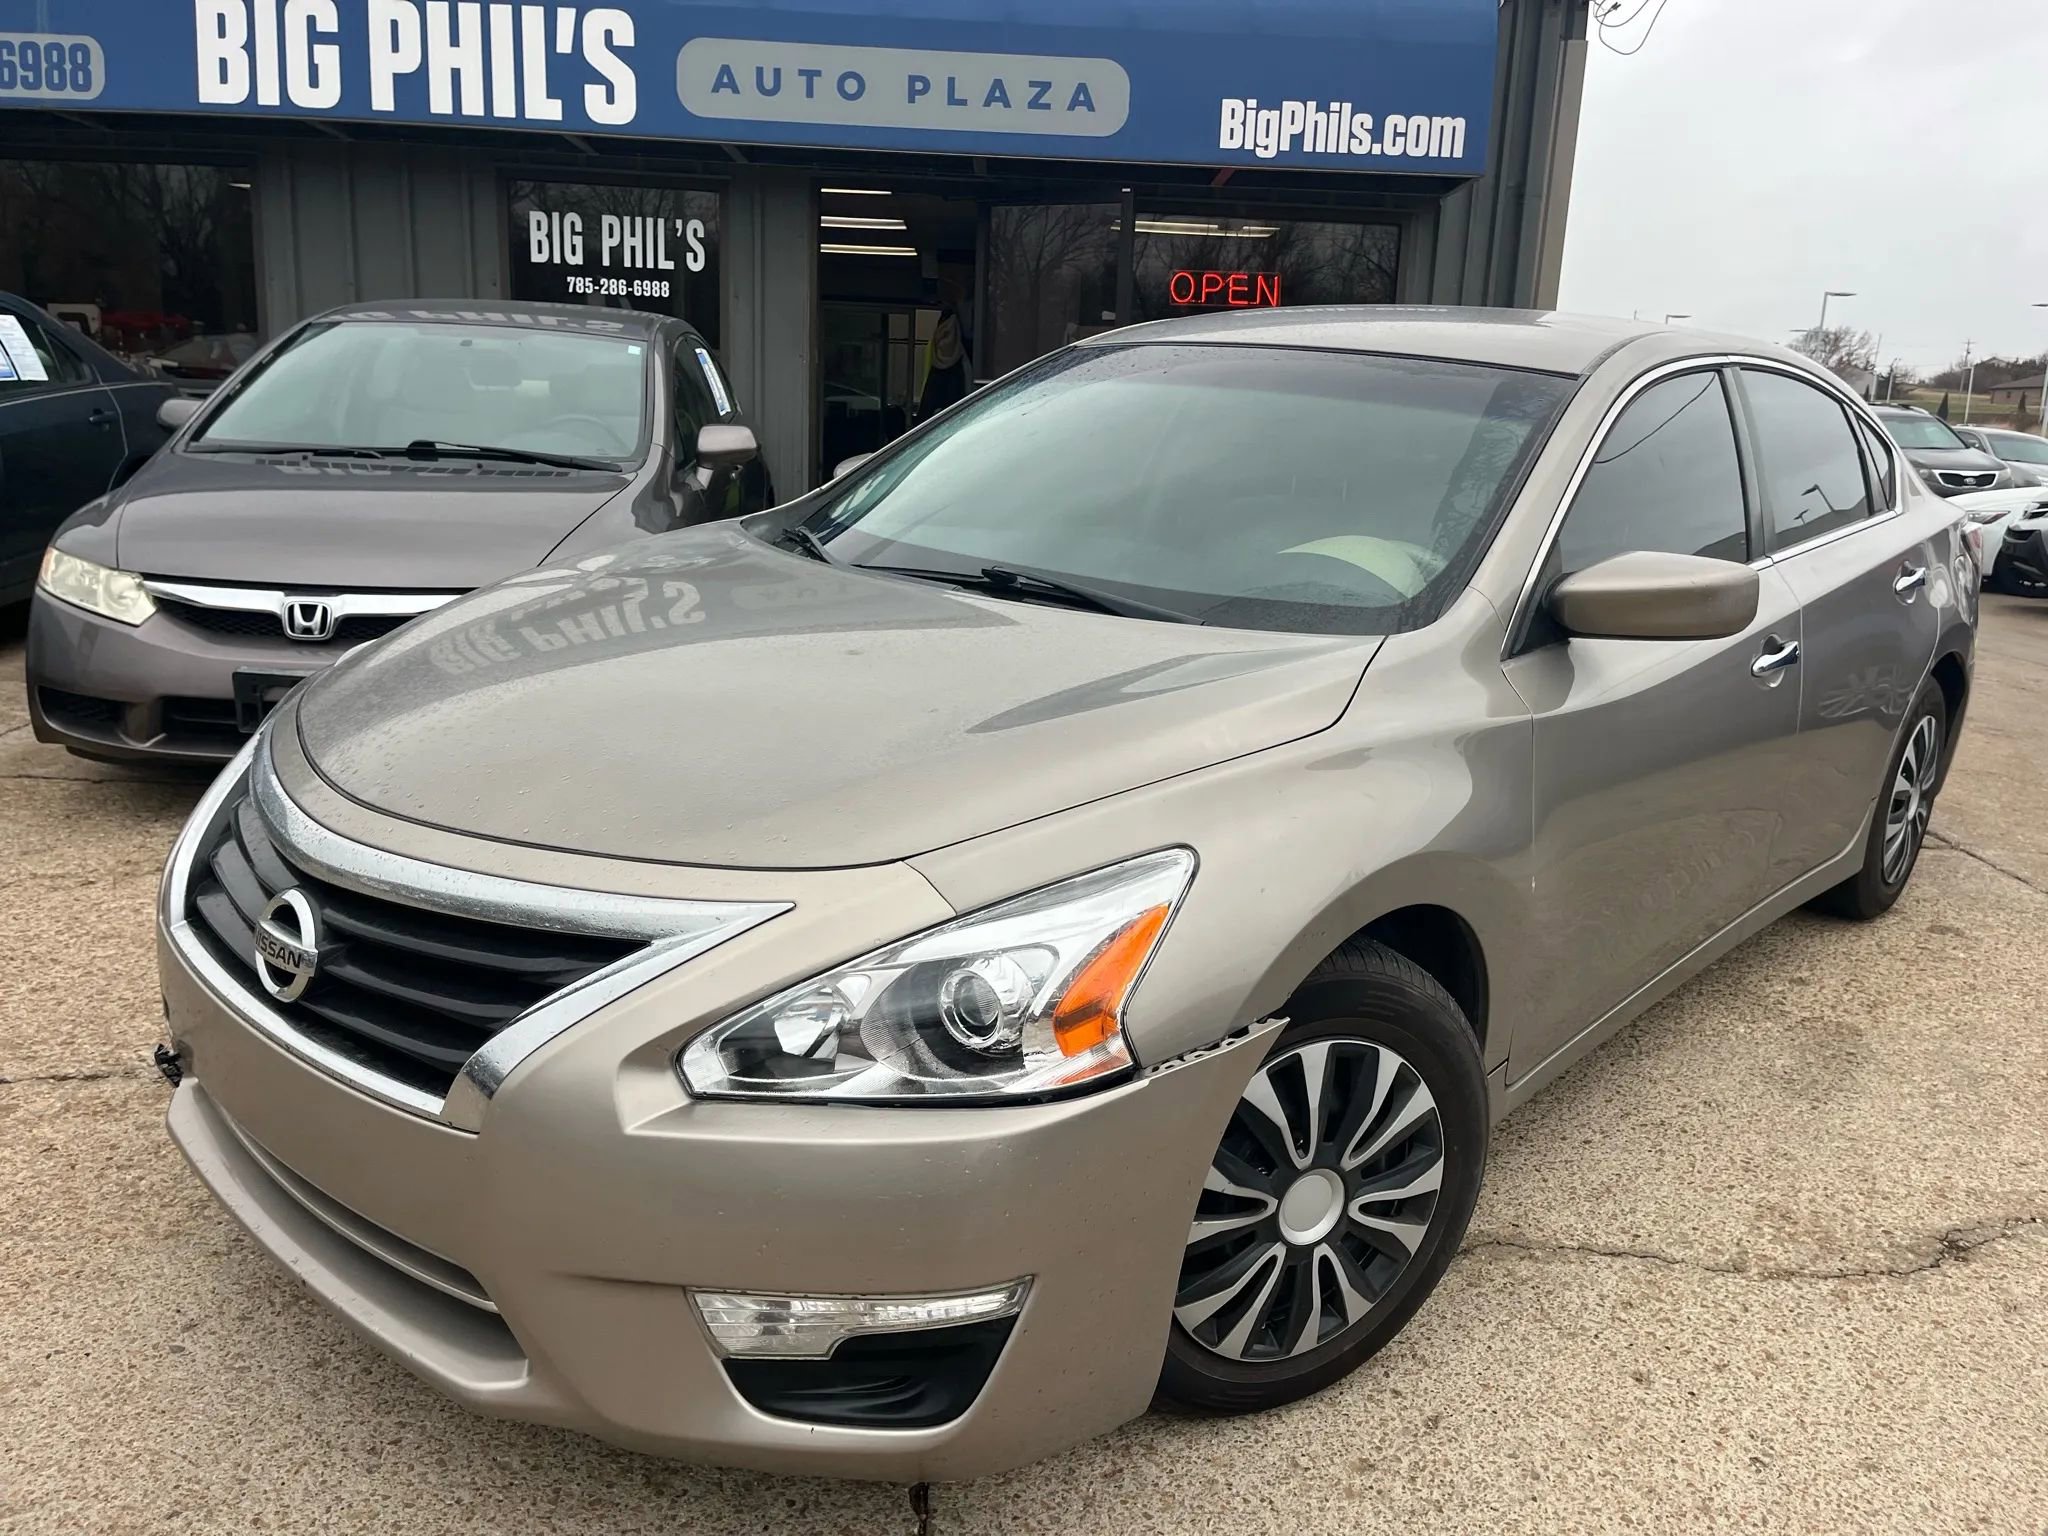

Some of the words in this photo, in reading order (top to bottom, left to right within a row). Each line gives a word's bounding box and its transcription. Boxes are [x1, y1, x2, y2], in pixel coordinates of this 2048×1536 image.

[0, 41, 92, 93] 6988
[196, 0, 341, 109] BIG
[368, 0, 637, 125] PHIL'S
[711, 64, 867, 102] AUTO
[907, 74, 1096, 113] PLAZA
[1219, 97, 1468, 160] BigPhils.com
[529, 211, 584, 266] BIG
[601, 215, 706, 273] PHIL'S
[566, 276, 671, 299] 785-286-6988
[1170, 271, 1280, 307] OPEN
[255, 929, 302, 969] NISSAN
